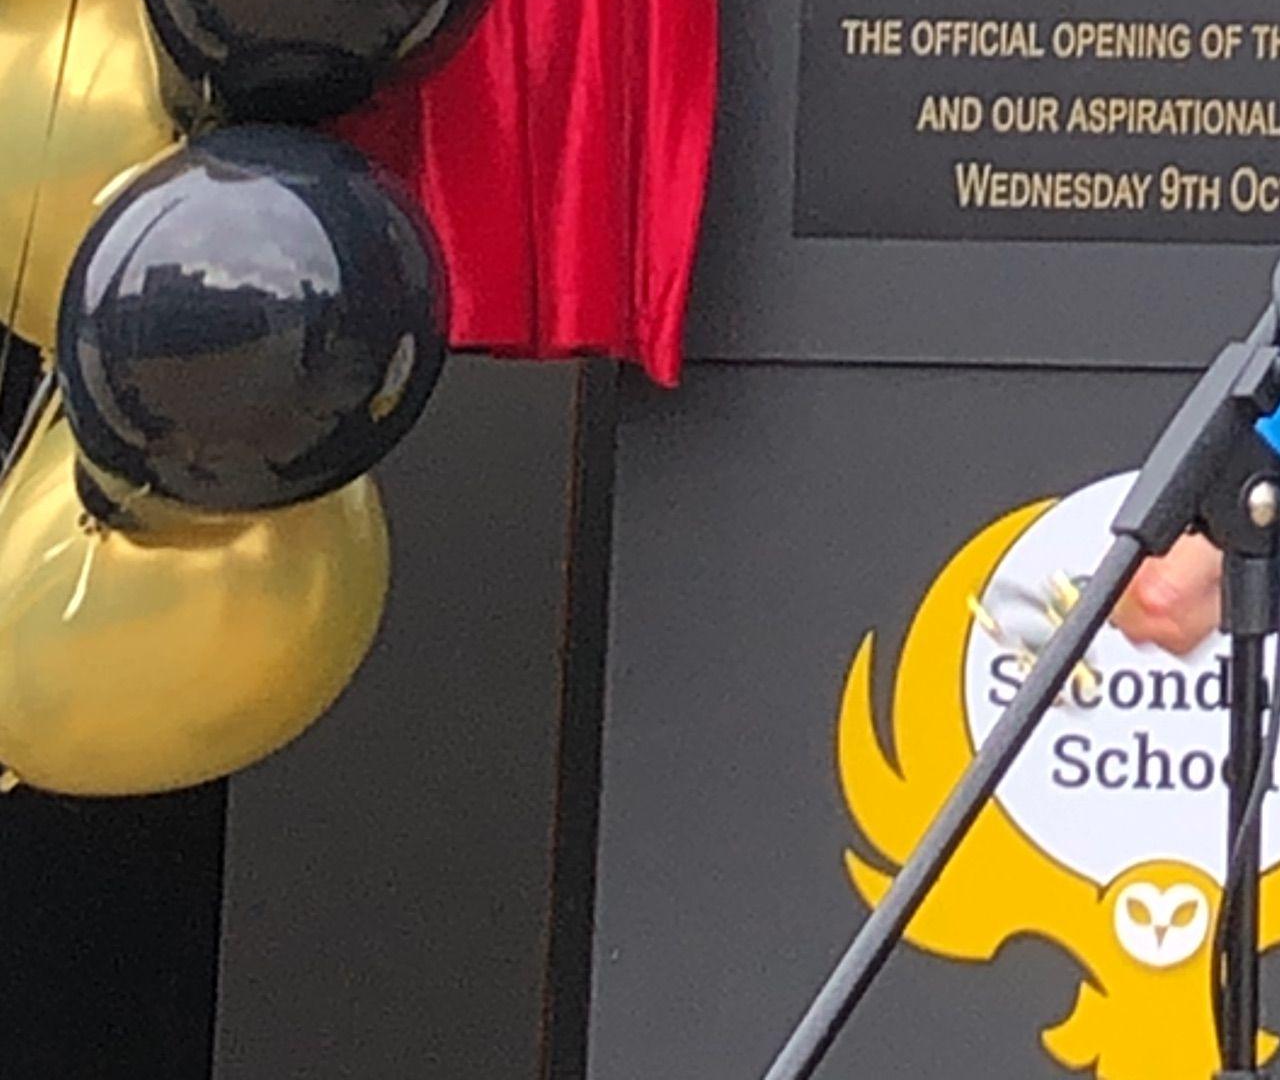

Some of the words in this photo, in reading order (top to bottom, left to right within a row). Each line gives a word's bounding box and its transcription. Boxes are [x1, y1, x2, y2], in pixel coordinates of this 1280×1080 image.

[841, 19, 903, 55] THE
[910, 20, 1045, 58] OFFICIAL
[1052, 22, 1192, 59] OPENING
[1200, 23, 1242, 60] OF
[916, 96, 983, 133] AND
[991, 97, 1059, 133] OUR
[954, 162, 1152, 210] WEDNESDAY
[1159, 165, 1221, 211] 9TH
[1051, 732, 1279, 792] Scho
